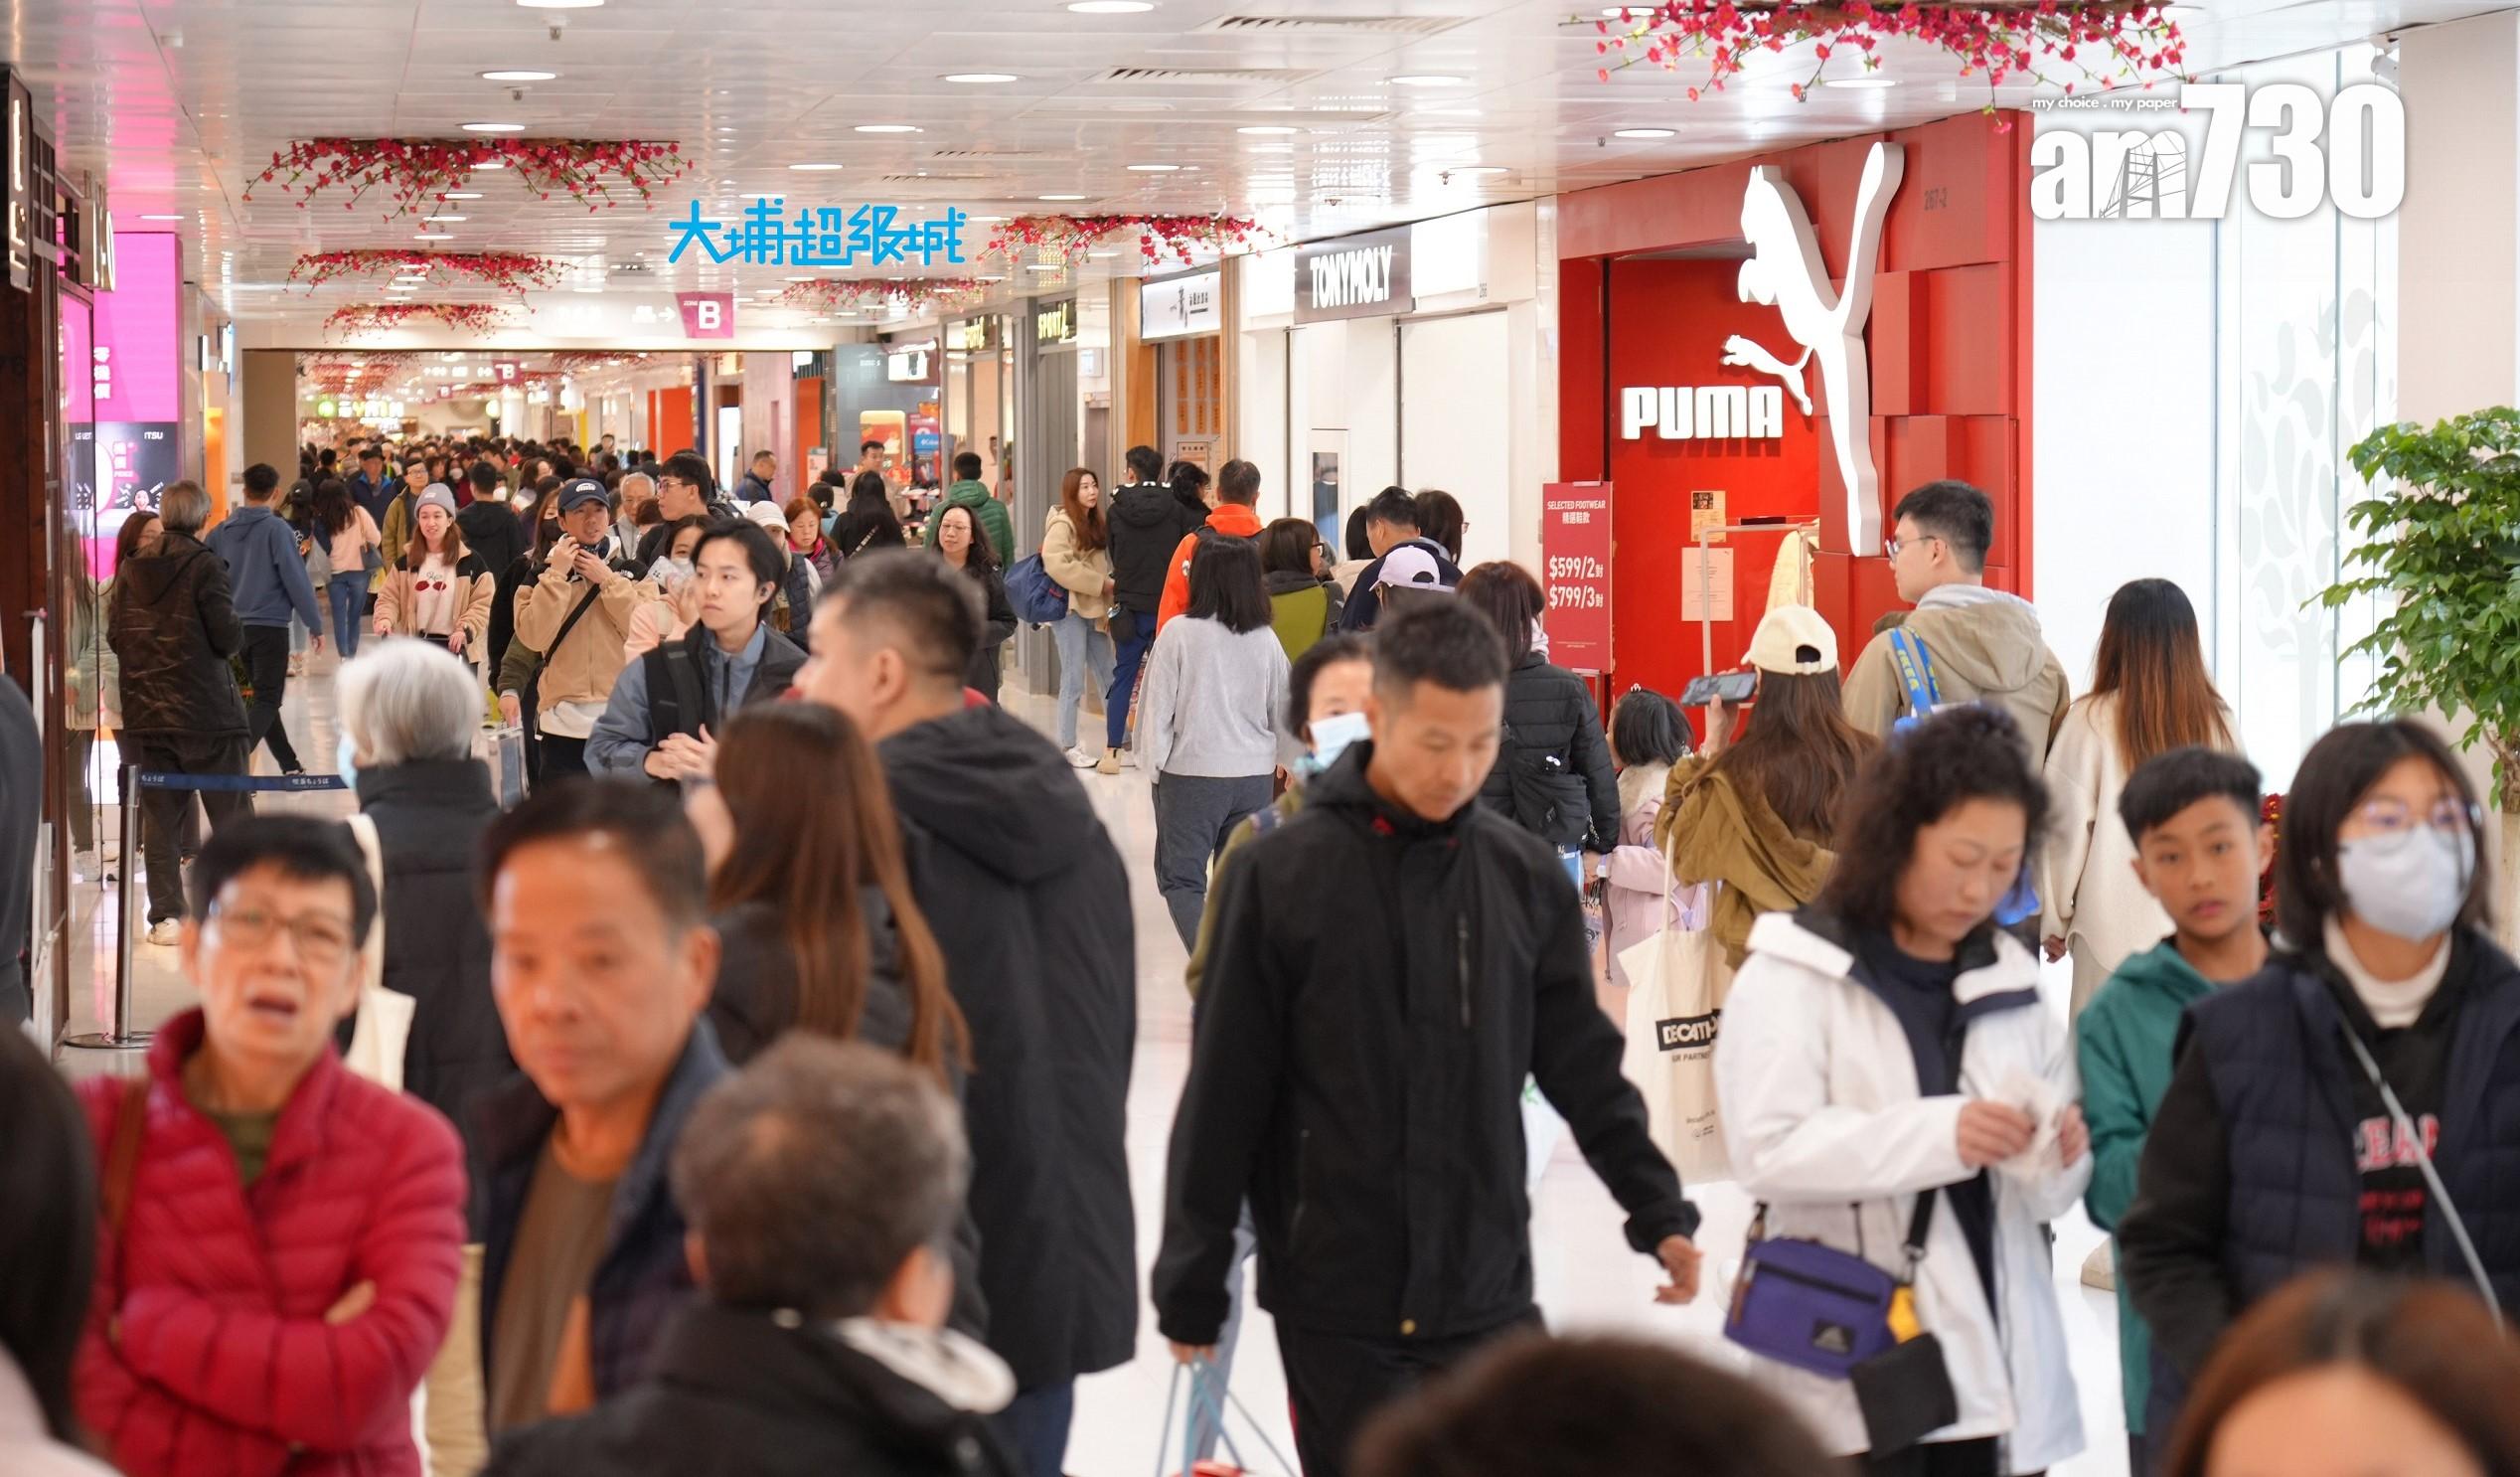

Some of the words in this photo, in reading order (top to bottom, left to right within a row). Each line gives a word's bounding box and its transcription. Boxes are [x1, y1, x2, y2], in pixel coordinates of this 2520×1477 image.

[1310, 245, 1393, 309] TONYMOLY
[699, 300, 721, 330] B
[1620, 386, 1784, 440] PUMA
[1547, 501, 1575, 510] SELECTED
[1575, 500, 1606, 509] FOOTWEAR
